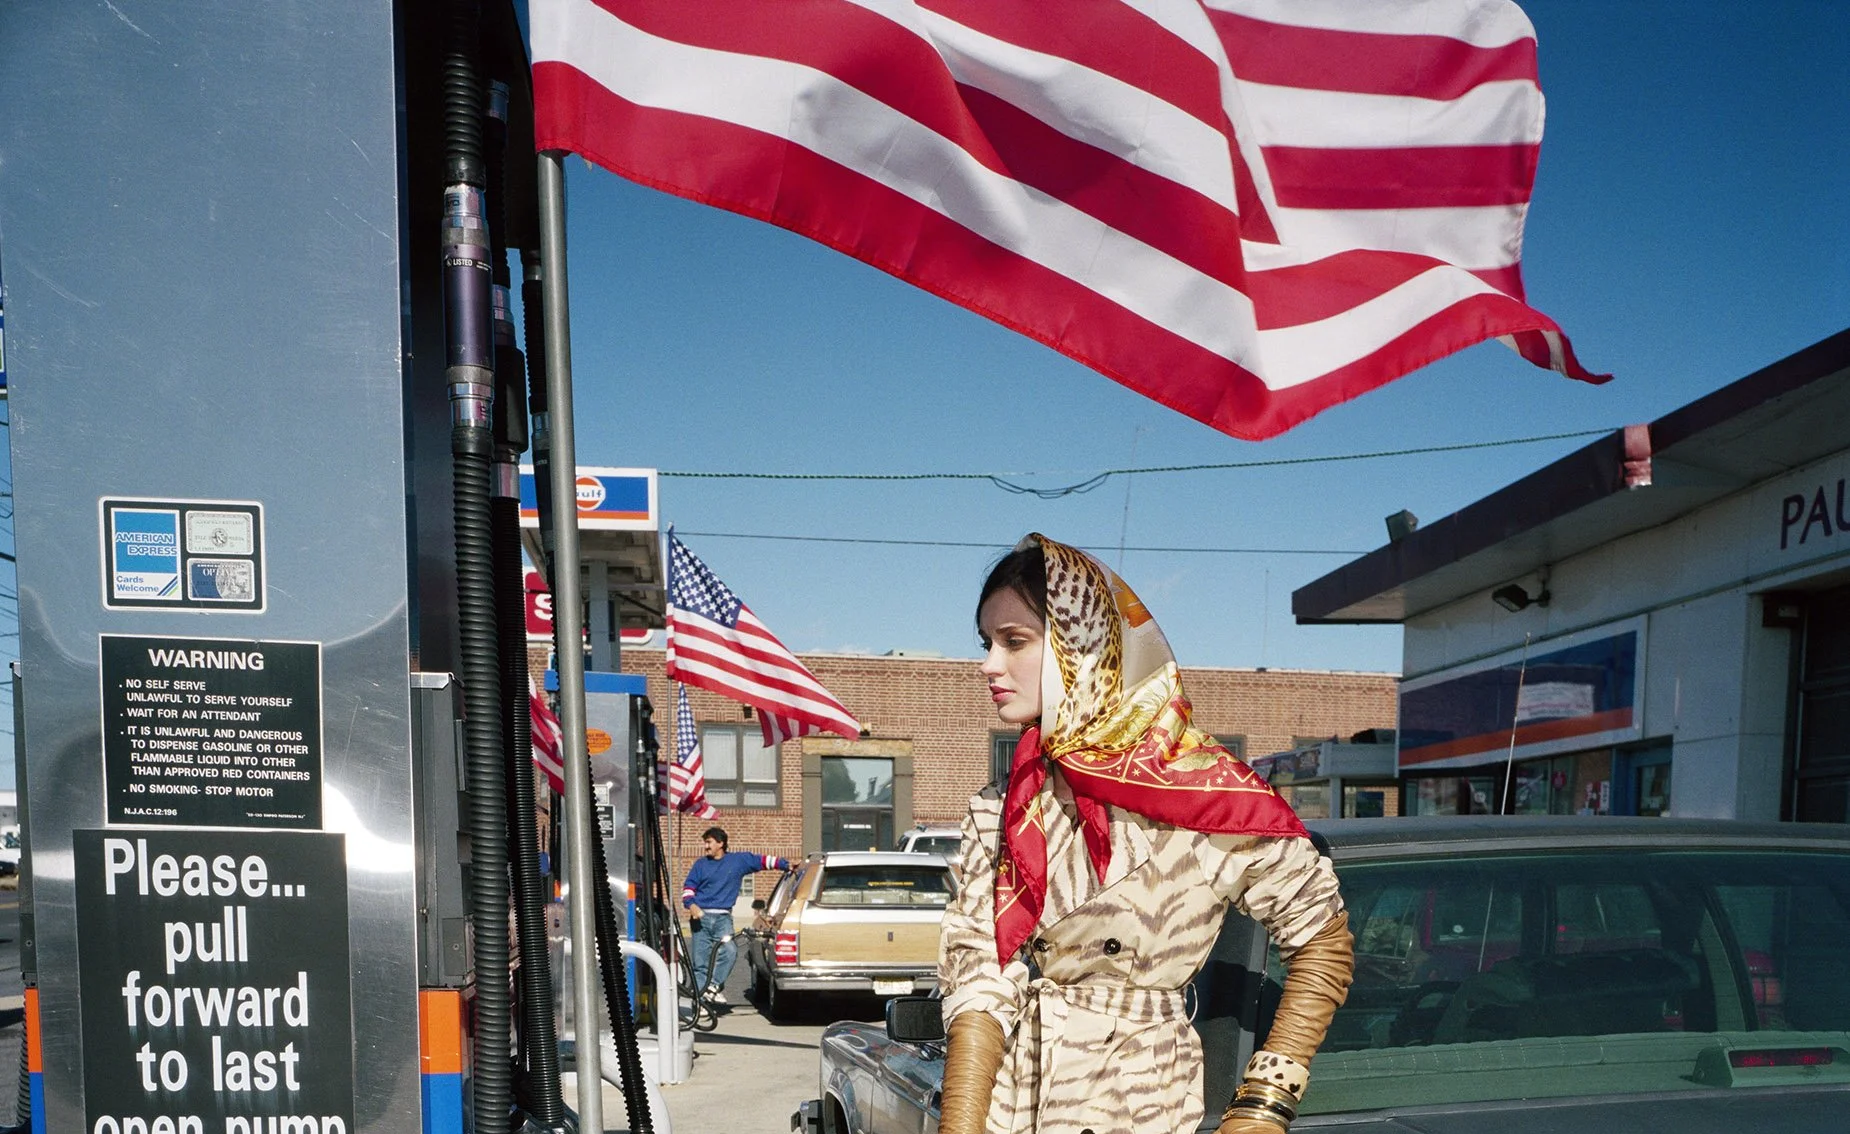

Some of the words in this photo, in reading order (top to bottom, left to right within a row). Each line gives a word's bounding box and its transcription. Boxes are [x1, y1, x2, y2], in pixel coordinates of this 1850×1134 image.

[115, 532, 174, 543] AMERICAN
[128, 546, 178, 556] EXPRESS
[116, 575, 144, 584] Cards
[116, 584, 159, 593] Welcome
[148, 649, 264, 670] WARNING
[126, 679, 142, 688] NO
[146, 679, 169, 689] SELF
[173, 680, 206, 691] SERVE
[127, 692, 183, 703] UNLAWFUL
[186, 694, 201, 704] TO
[204, 695, 237, 705] SERVE
[240, 696, 292, 707] YOURSELF
[127, 708, 154, 717] WAIT
[157, 709, 178, 718] FOR
[182, 710, 197, 719] AN
[201, 710, 261, 721] ATTENDANT
[127, 726, 137, 735] IT
[141, 726, 151, 736] IS
[154, 726, 210, 737] UNLAWFUL
[213, 729, 236, 738] AND
[239, 729, 303, 741] DANGEROUS
[130, 739, 146, 749] TO
[149, 740, 199, 750] DISPENSE
[202, 741, 252, 752] GASOLINE
[256, 743, 271, 753] OR
[275, 744, 308, 754] OTHER
[131, 752, 194, 764] FLAMMABLE
[197, 755, 231, 765] LIQUID
[234, 756, 258, 766] INTO
[262, 757, 296, 767] OTHER
[132, 766, 161, 776] THAN
[164, 767, 219, 778] APPROVED
[222, 769, 243, 778] RED
[246, 769, 310, 781] CONTAINERS
[130, 784, 146, 793] NO
[149, 784, 201, 795] SMOKING-
[205, 785, 232, 795] STOP
[236, 787, 273, 797] MOTOR
[104, 838, 305, 897] Please...
[164, 905, 248, 975] pull
[122, 970, 309, 1027] forward
[136, 1042, 188, 1092] to
[212, 1035, 300, 1092] last
